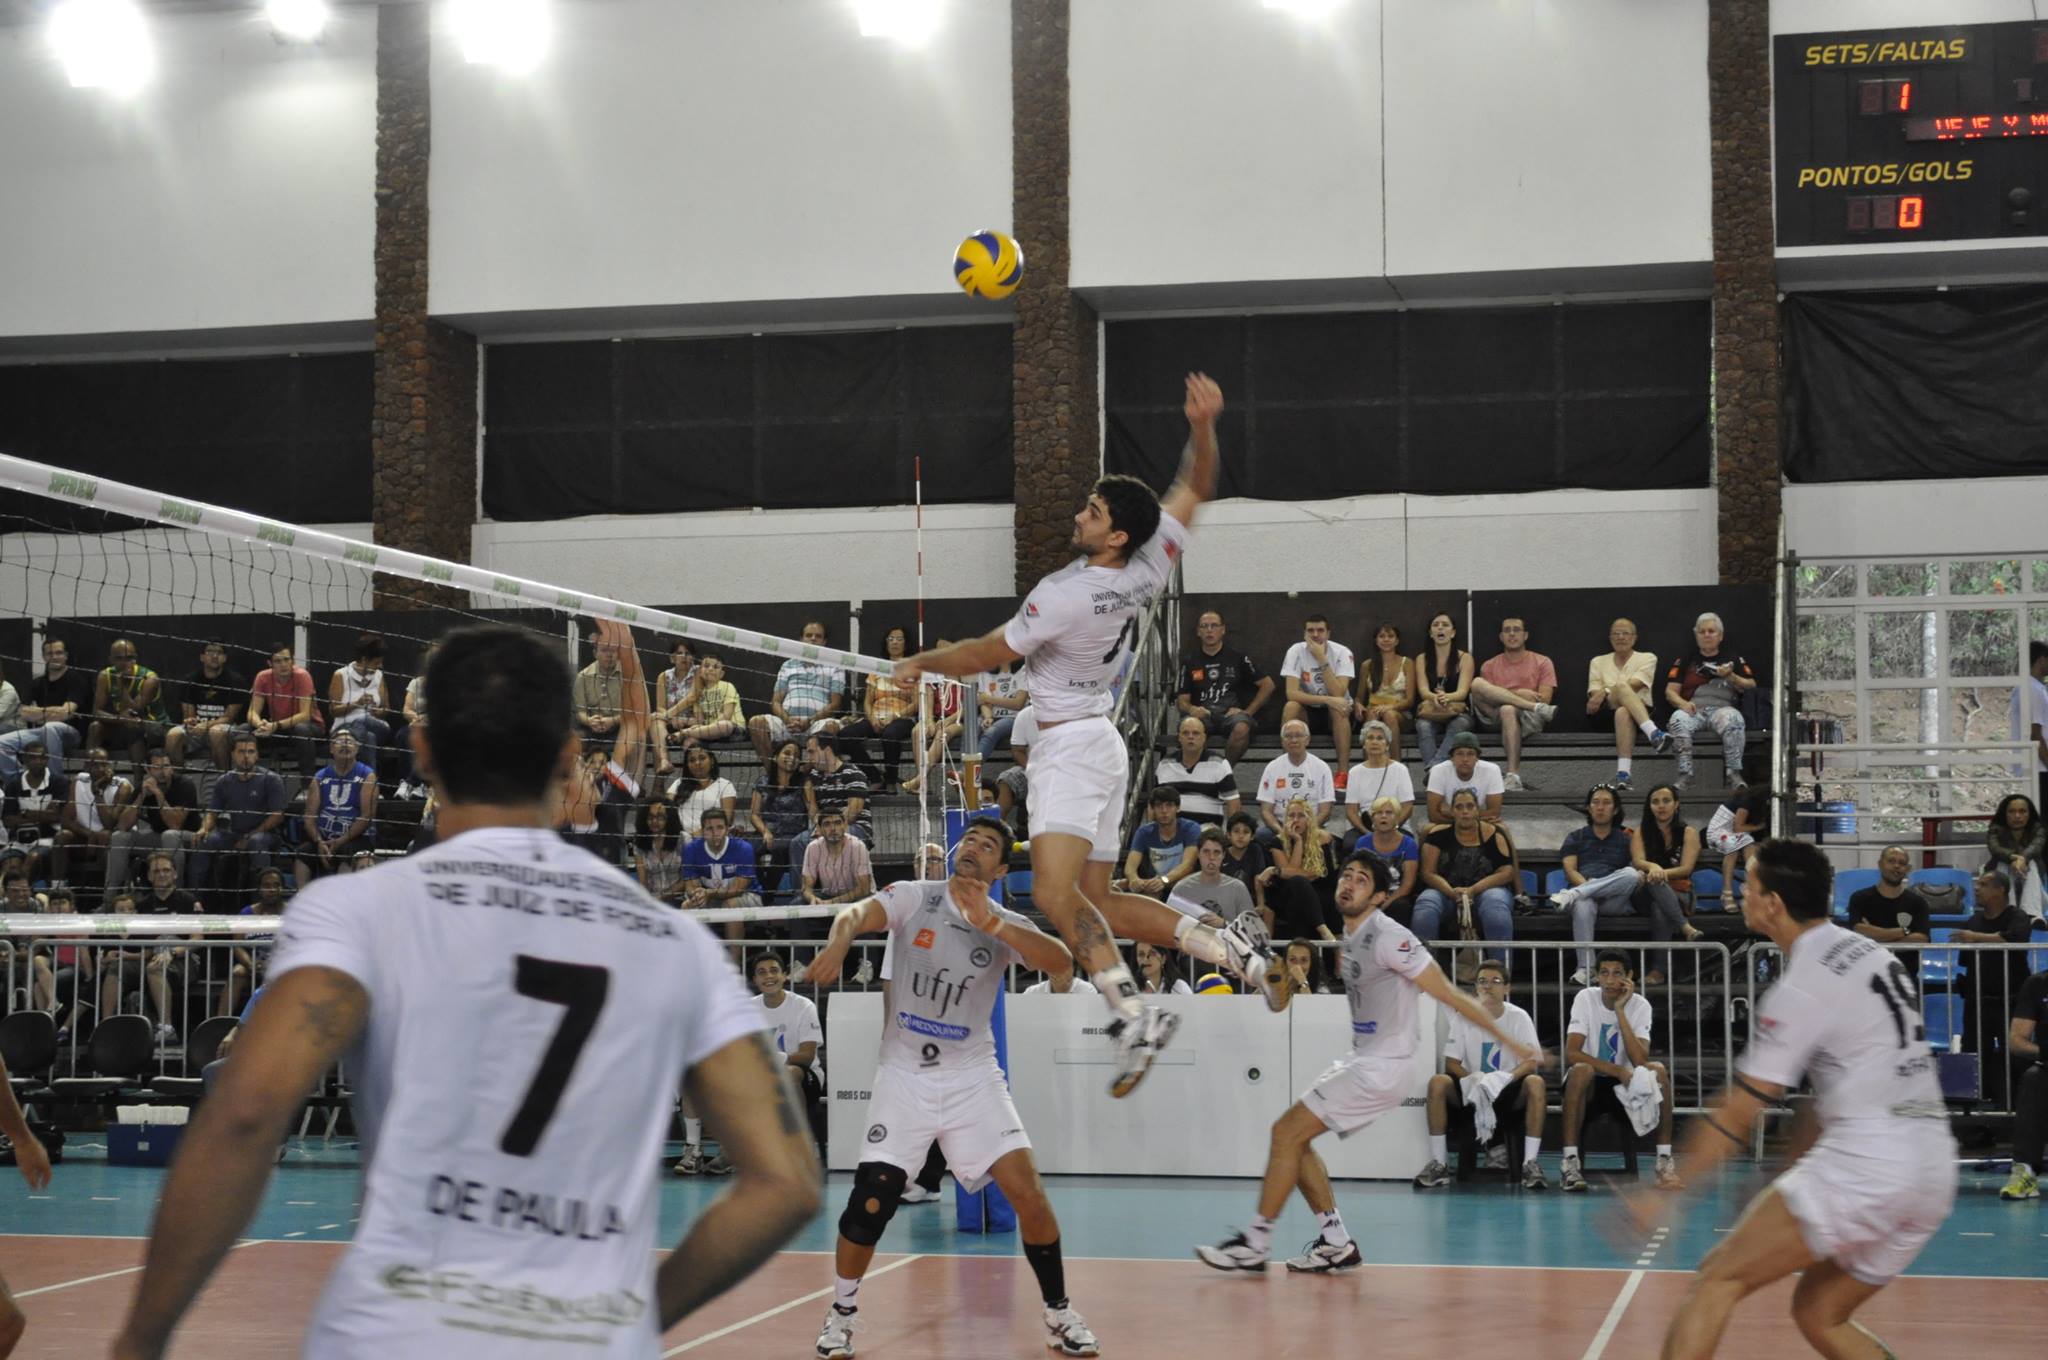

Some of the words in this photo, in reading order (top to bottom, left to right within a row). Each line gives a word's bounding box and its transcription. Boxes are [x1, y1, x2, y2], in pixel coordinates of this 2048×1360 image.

[1805, 39, 1966, 66] SETS/FALTAS
[1899, 82, 1911, 111] 1
[1798, 160, 1974, 188] PONTOS/GOLS
[1898, 197, 1923, 228] 0
[1094, 604, 1108, 615] DE
[424, 882, 470, 906] DE
[477, 884, 547, 916] JUIZ
[553, 898, 598, 923] DE
[912, 967, 975, 1019] ufjf
[500, 953, 610, 1158] 7
[425, 1173, 483, 1222] DE
[487, 1186, 625, 1242] PAULA
